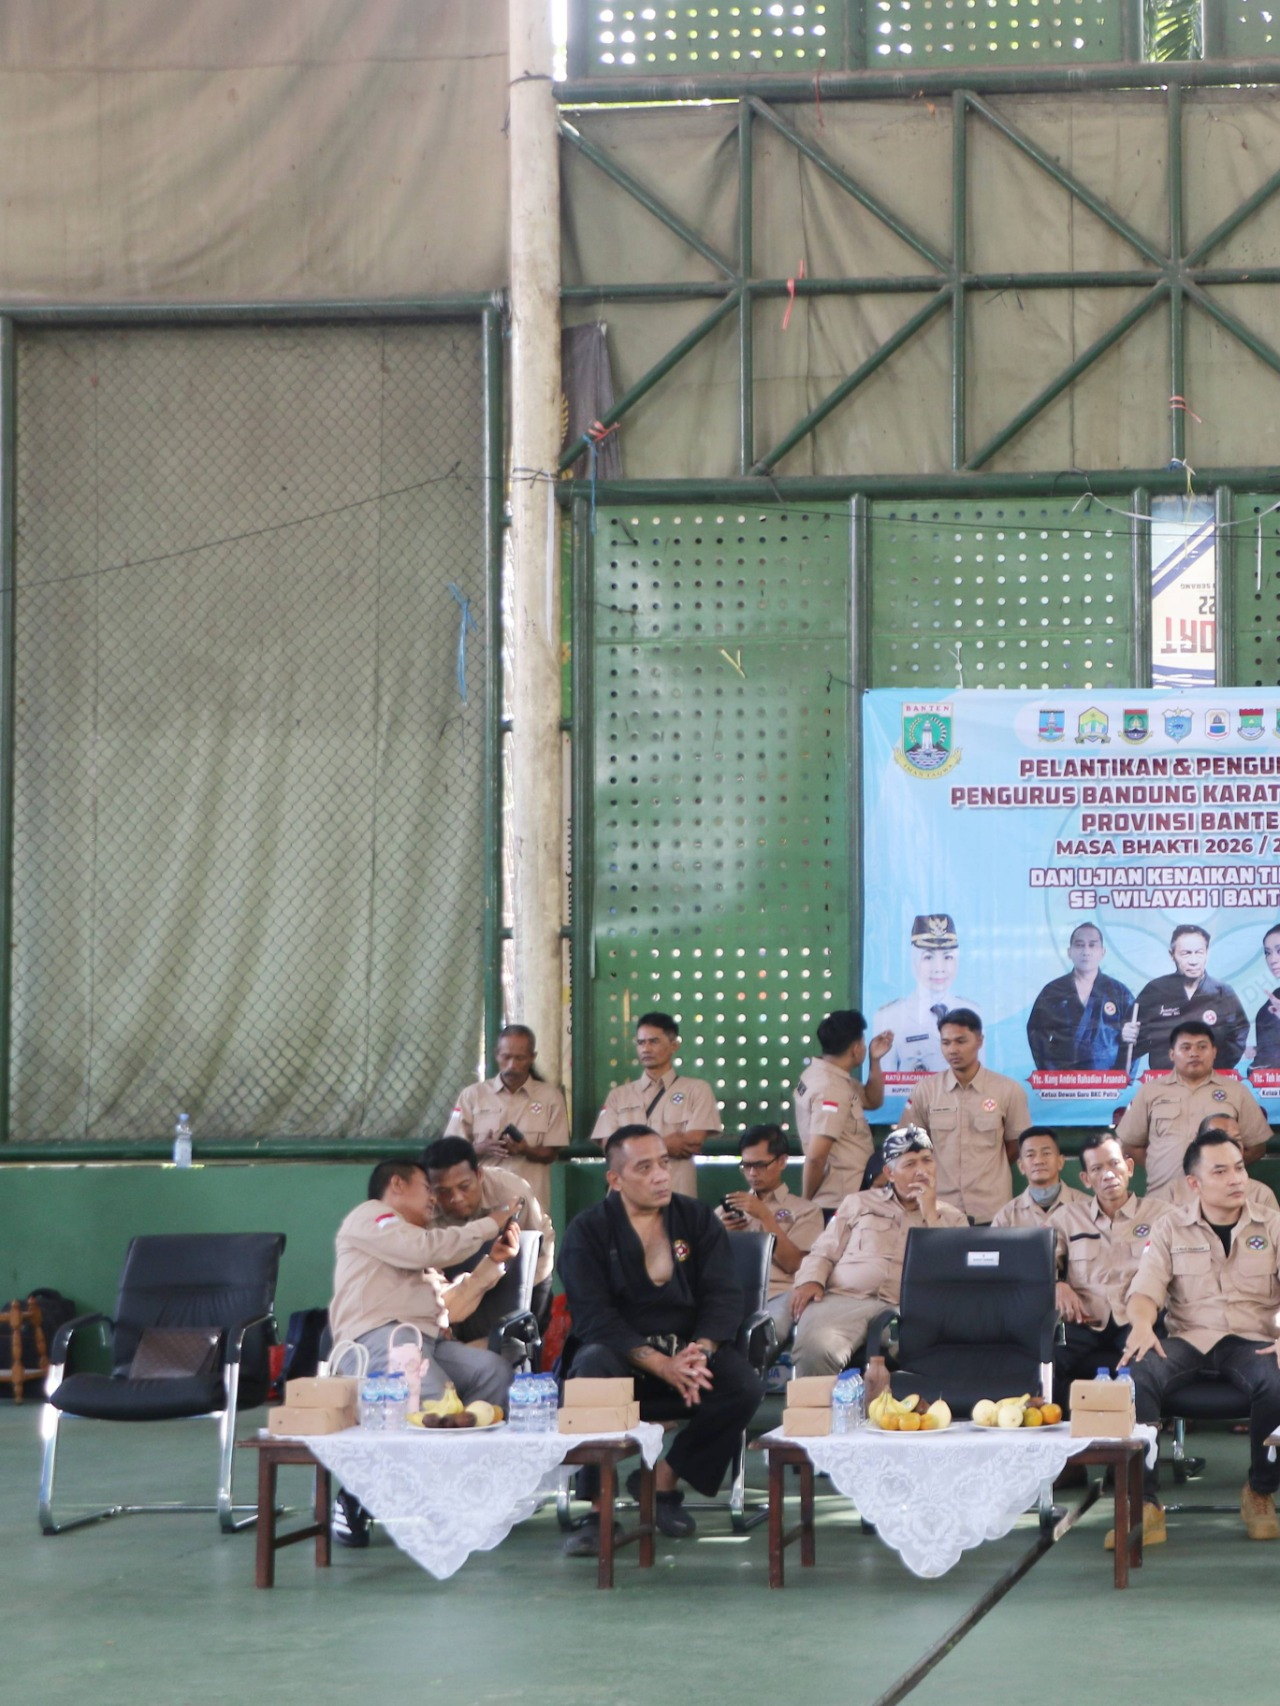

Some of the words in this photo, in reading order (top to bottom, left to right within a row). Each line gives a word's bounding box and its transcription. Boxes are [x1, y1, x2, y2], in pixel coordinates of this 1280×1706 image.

[1019, 757, 1168, 778] PELANTIKAN
[1172, 757, 1192, 777] &
[951, 786, 1076, 806] PENGURUS
[1082, 785, 1197, 804] BANDUNG
[1081, 813, 1194, 832] PROVINSI
[1056, 839, 1116, 855] MASA
[1123, 839, 1199, 854] BHAKTI
[1205, 838, 1253, 853] 2026
[1258, 835, 1268, 855] /
[1030, 868, 1075, 887] DAN
[1078, 867, 1144, 886] UJIAN
[1147, 866, 1255, 886] KENAIKAN
[1069, 890, 1097, 909] SE
[1112, 889, 1208, 908] WILAYAH
[1209, 888, 1219, 907] 1
[1045, 1074, 1058, 1086] Kang
